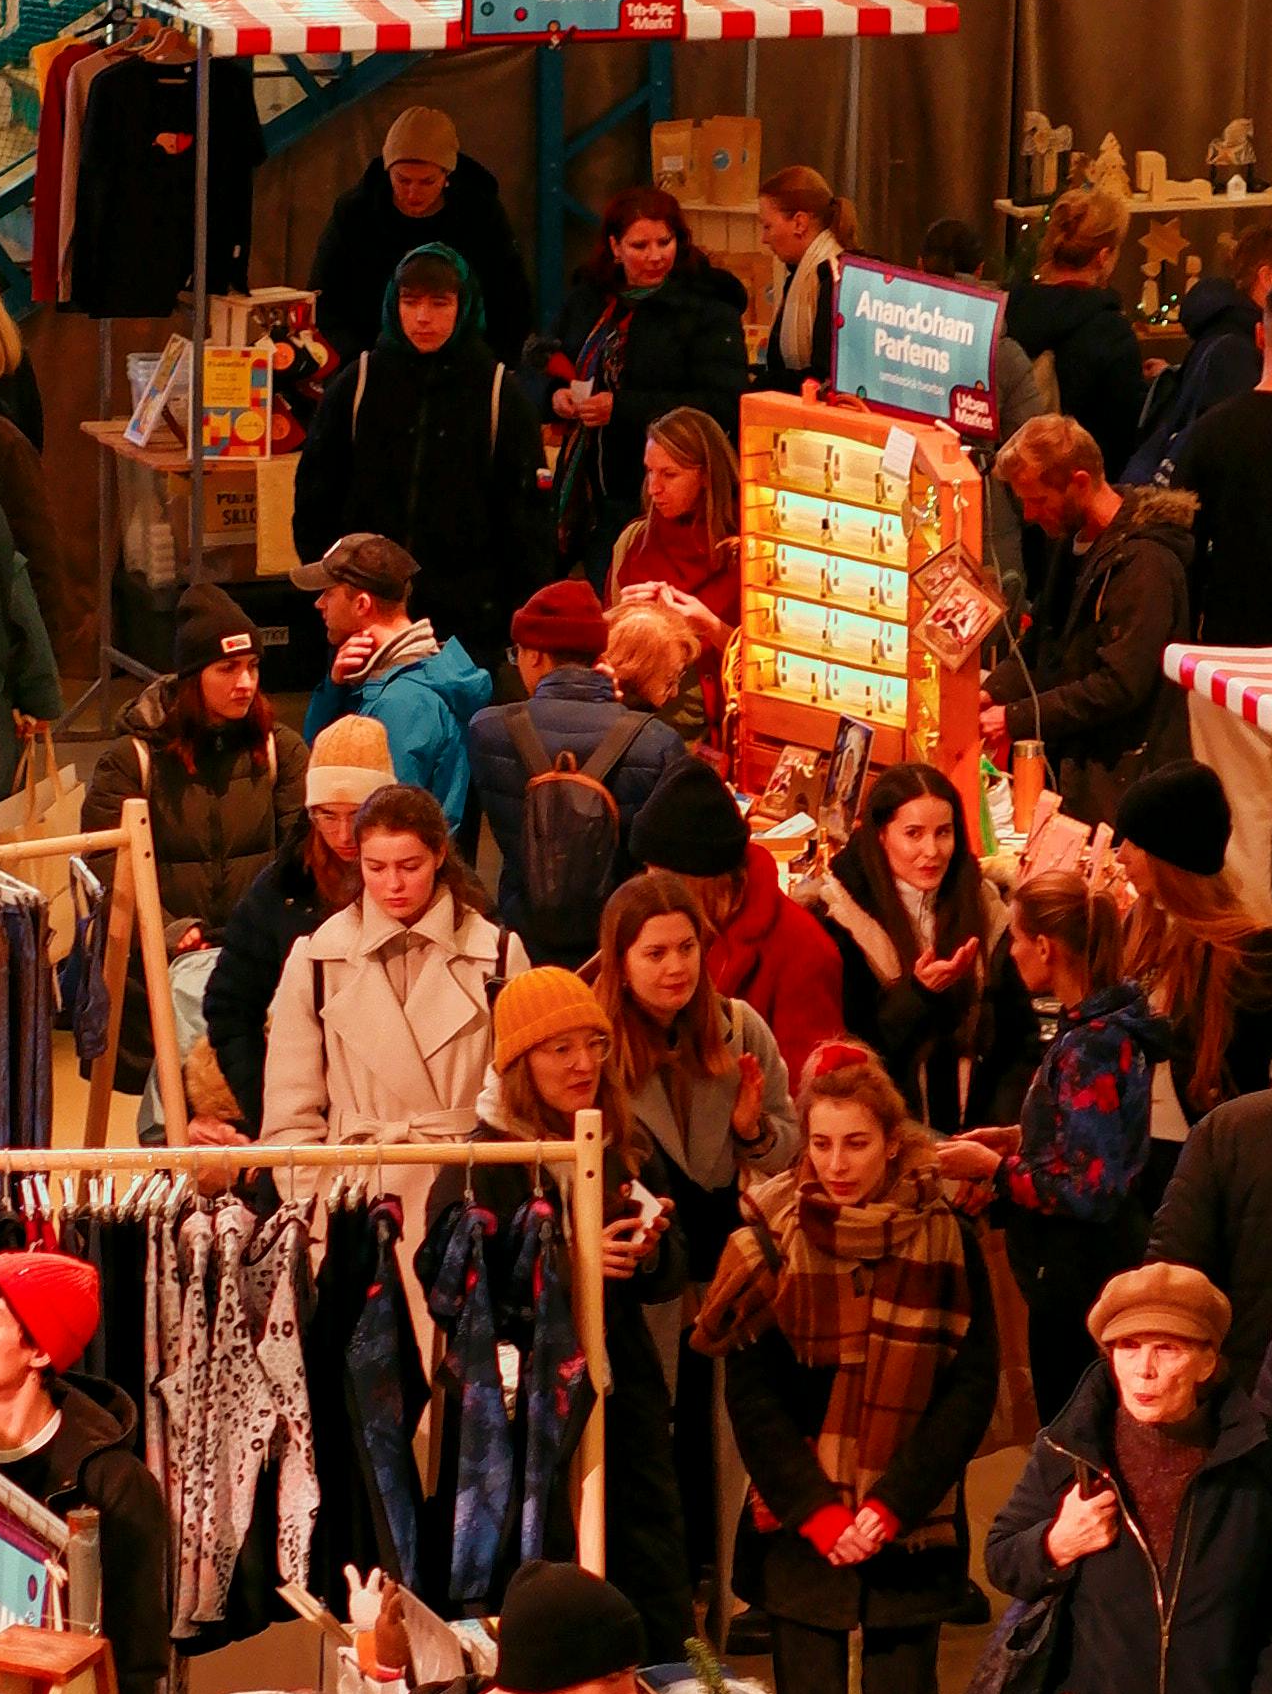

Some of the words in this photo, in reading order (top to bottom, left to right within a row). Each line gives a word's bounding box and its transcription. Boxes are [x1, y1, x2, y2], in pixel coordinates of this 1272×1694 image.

[855, 290, 975, 346] Anandoham
[874, 328, 950, 374] Parfems
[955, 407, 993, 431] Market
[956, 392, 989, 415] Urban
